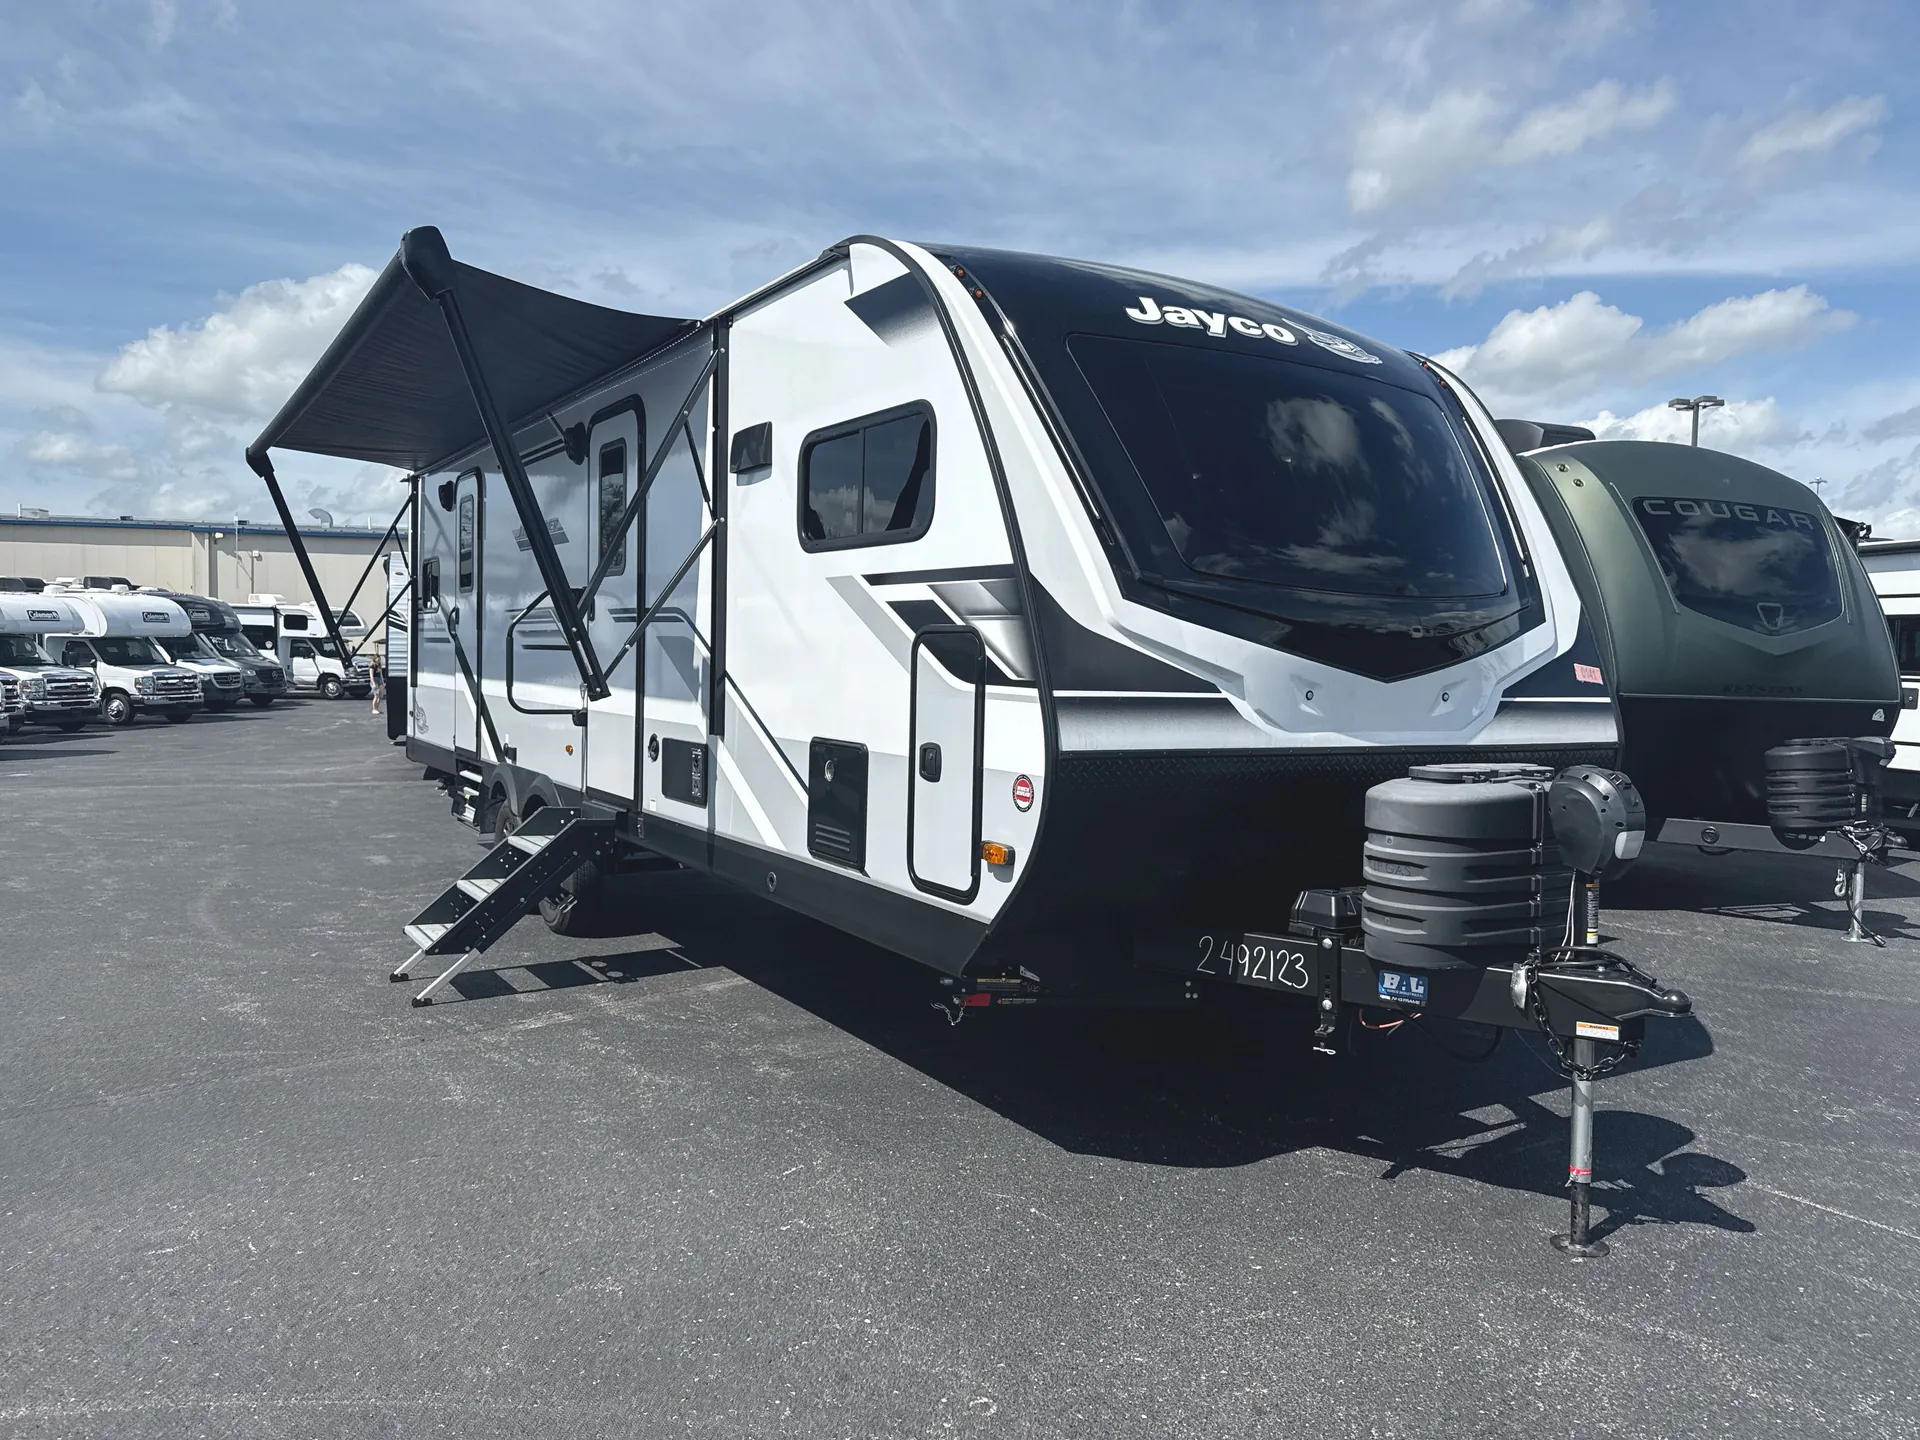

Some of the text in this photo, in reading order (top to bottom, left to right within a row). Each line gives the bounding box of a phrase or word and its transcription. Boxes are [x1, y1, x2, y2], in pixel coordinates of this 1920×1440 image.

[1123, 296, 1299, 346] Jayco
[1643, 499, 1814, 530] COUGAR
[28, 610, 53, 619] Coleman
[143, 612, 165, 620] Coleman
[1196, 935, 1309, 989] 2492123
[1383, 973, 1425, 993] BAL
